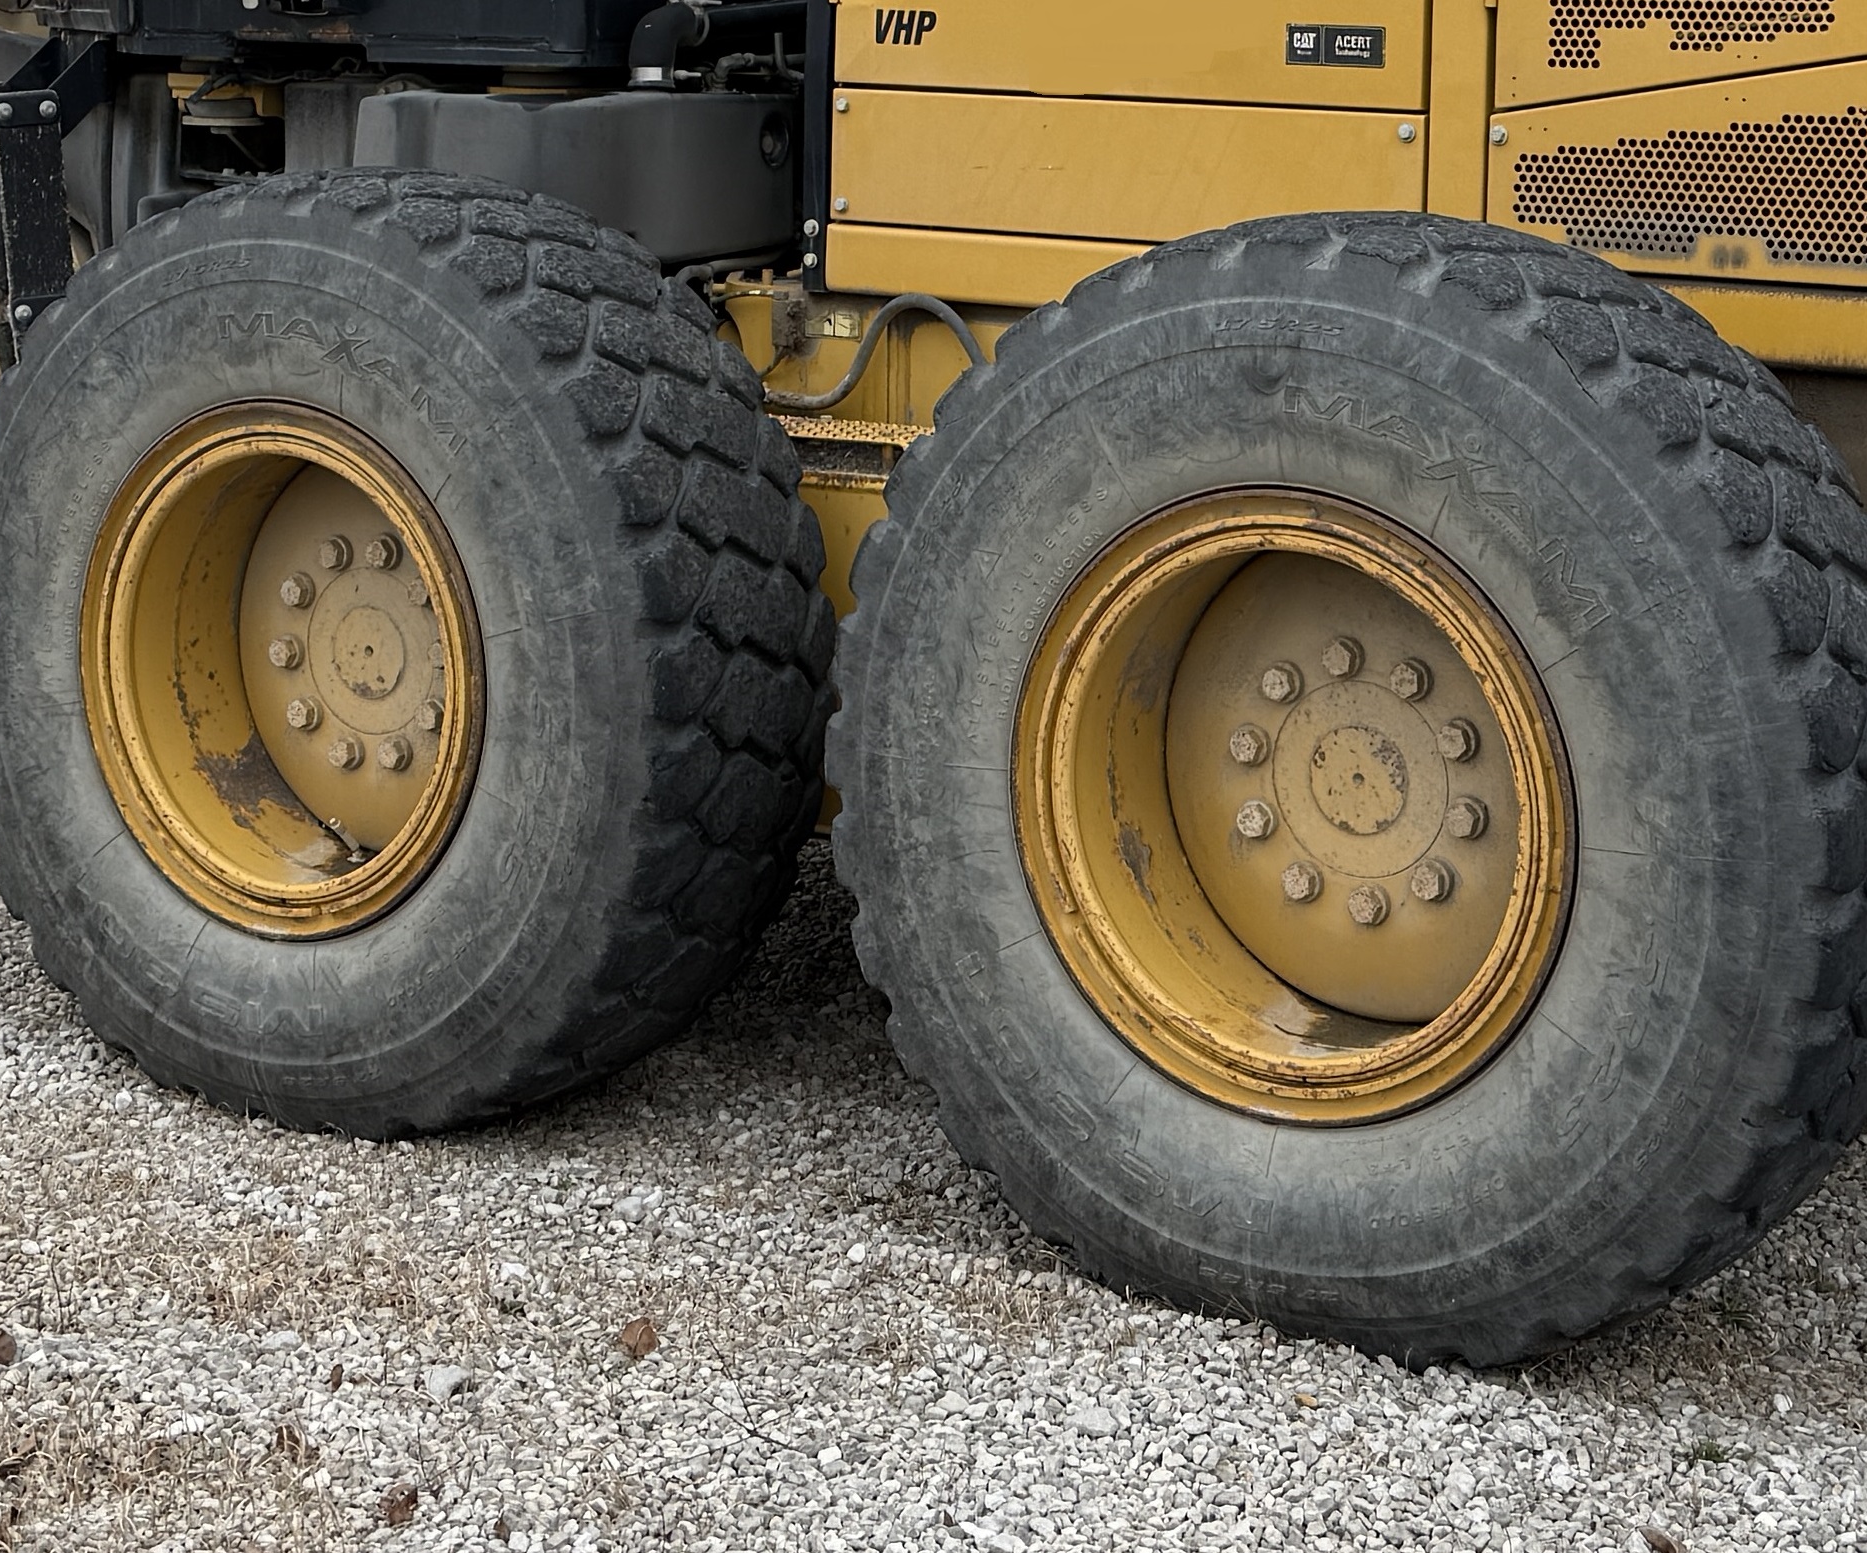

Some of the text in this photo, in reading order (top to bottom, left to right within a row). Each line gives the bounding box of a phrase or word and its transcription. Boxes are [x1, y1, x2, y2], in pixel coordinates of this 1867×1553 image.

[874, 8, 938, 46] VHP
[1293, 32, 1372, 49] CAT ACERT
[219, 312, 467, 458] MAXAM
[1282, 384, 1612, 632] MAXAM
[996, 653, 1022, 720] RADIAL
[1017, 527, 1104, 644] CONSTRUCTION
